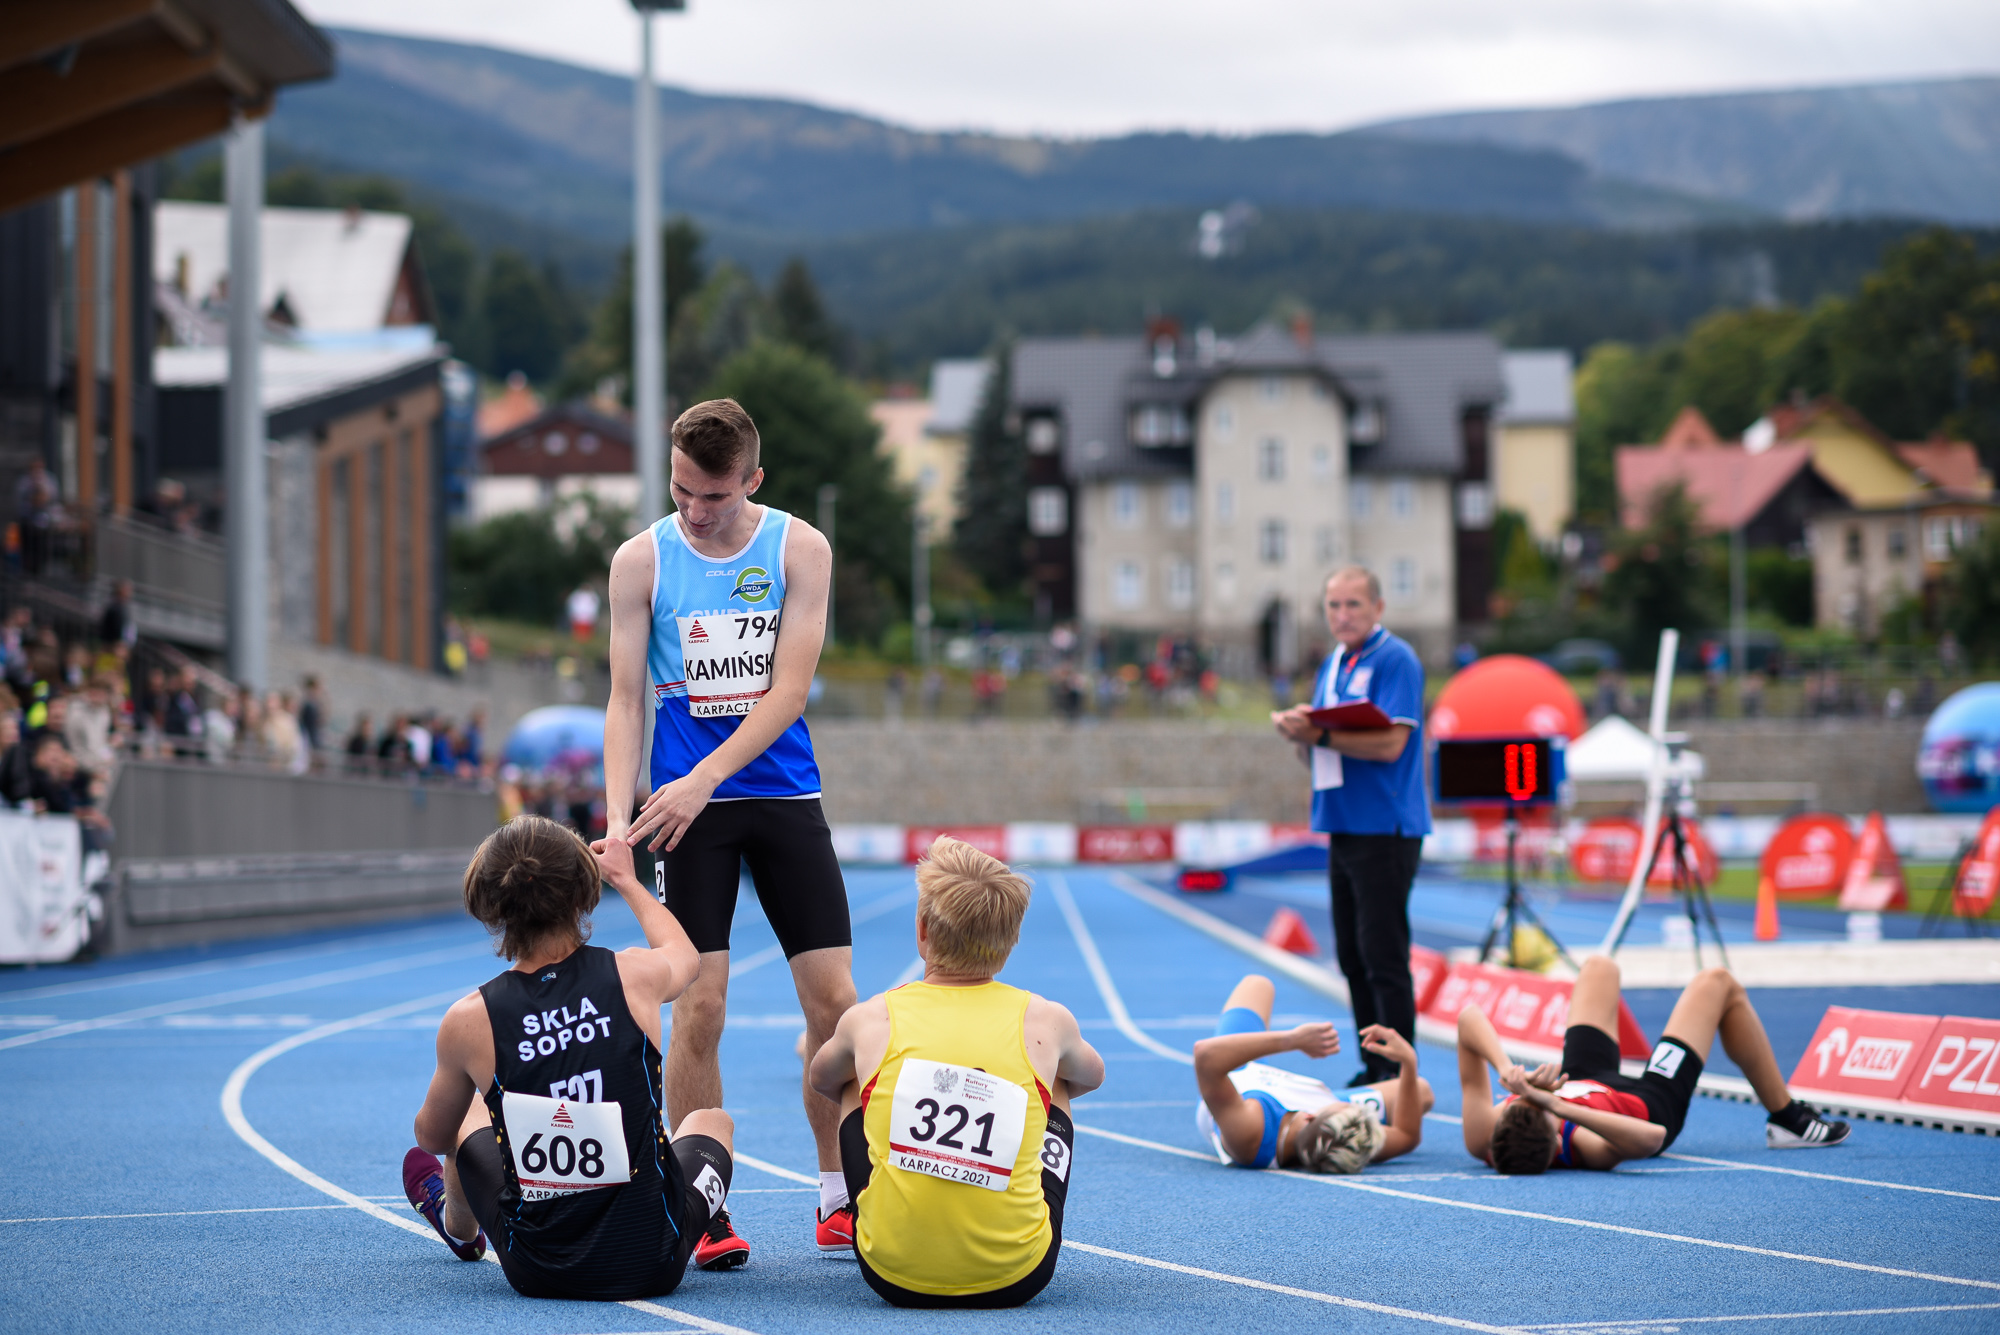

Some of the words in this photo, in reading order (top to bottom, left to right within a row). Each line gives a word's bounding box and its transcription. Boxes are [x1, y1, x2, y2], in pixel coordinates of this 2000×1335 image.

[734, 614, 777, 640] 794
[696, 702, 750, 716] KARPACZ
[656, 869, 664, 897] 2
[522, 996, 599, 1035] SKLA
[517, 1016, 611, 1062] SOPOT
[1654, 1049, 1673, 1072] 7
[1849, 1046, 1904, 1071] ORLEN
[1919, 1034, 2000, 1097] PZL
[909, 1097, 996, 1158] 321
[521, 1132, 605, 1179] 608
[1041, 1137, 1064, 1169] 8
[899, 1156, 959, 1179] KARPACZ
[961, 1169, 991, 1186] 2021
[704, 1174, 722, 1205] 3
